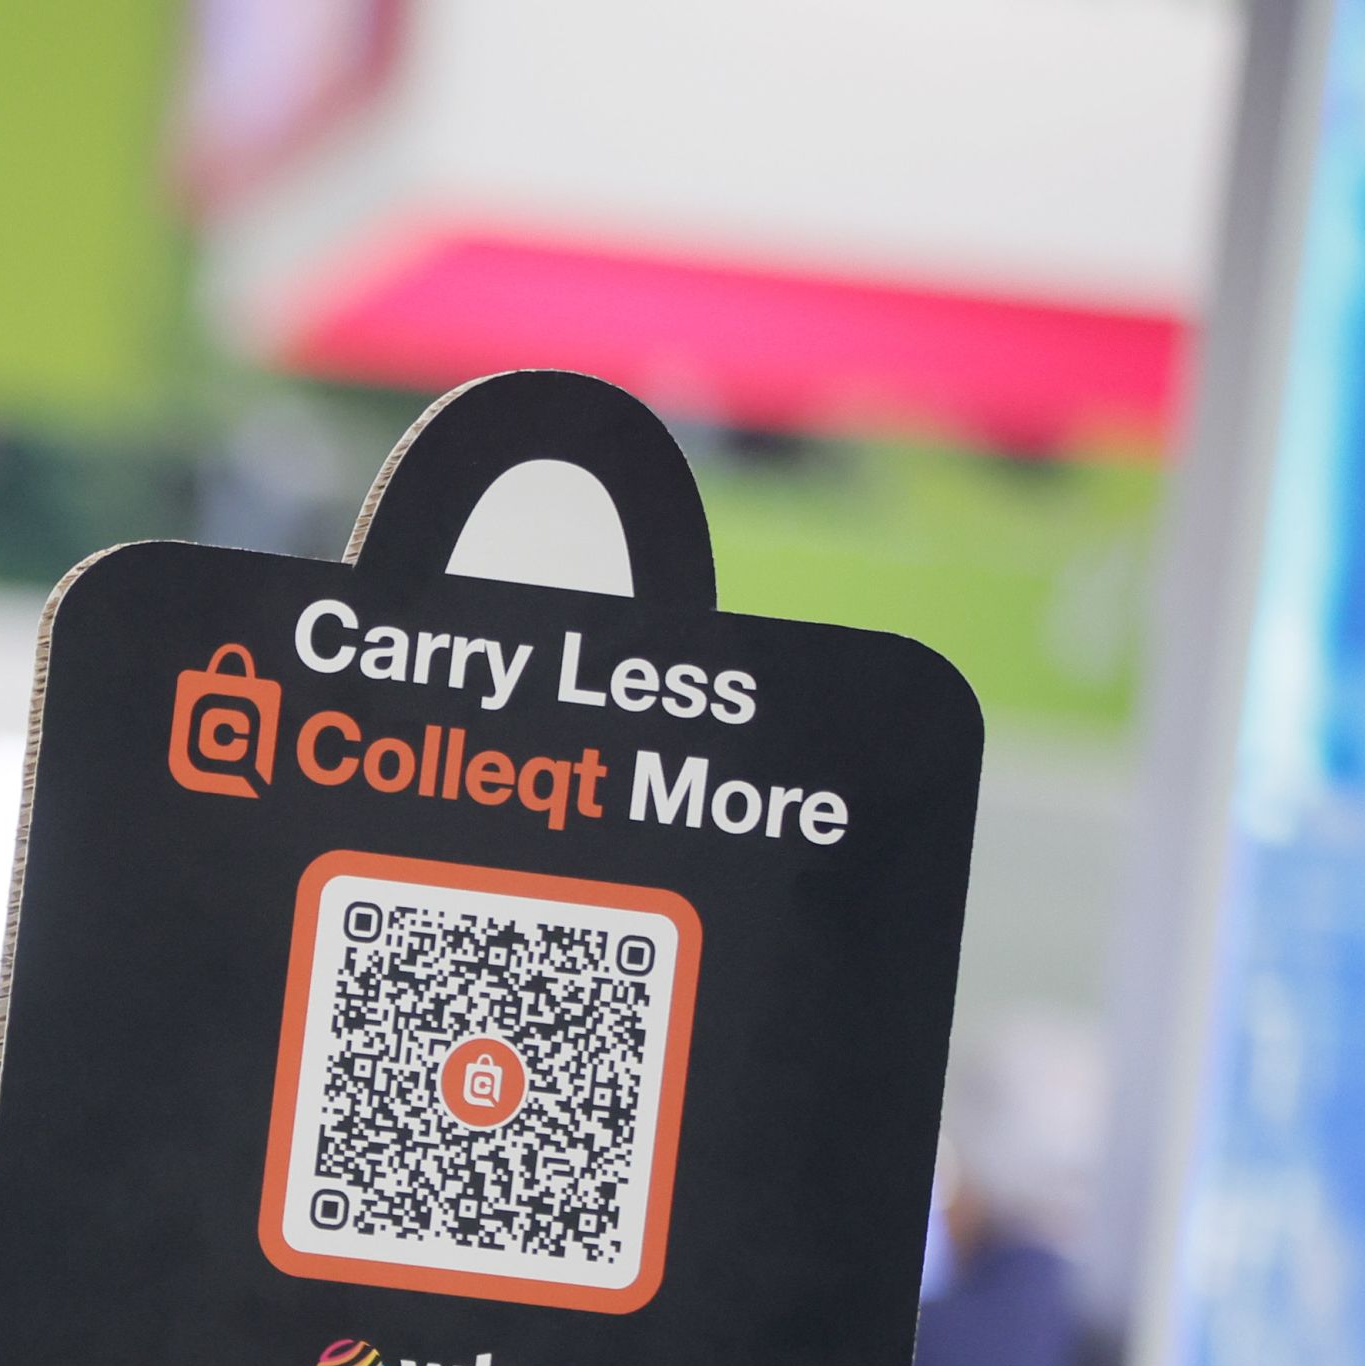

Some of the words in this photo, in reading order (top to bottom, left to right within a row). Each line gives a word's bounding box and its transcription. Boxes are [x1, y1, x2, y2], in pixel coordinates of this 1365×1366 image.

[295, 599, 533, 711] Carry
[557, 631, 757, 724] Less
[296, 710, 607, 830] Colleqt
[629, 749, 848, 845] More
